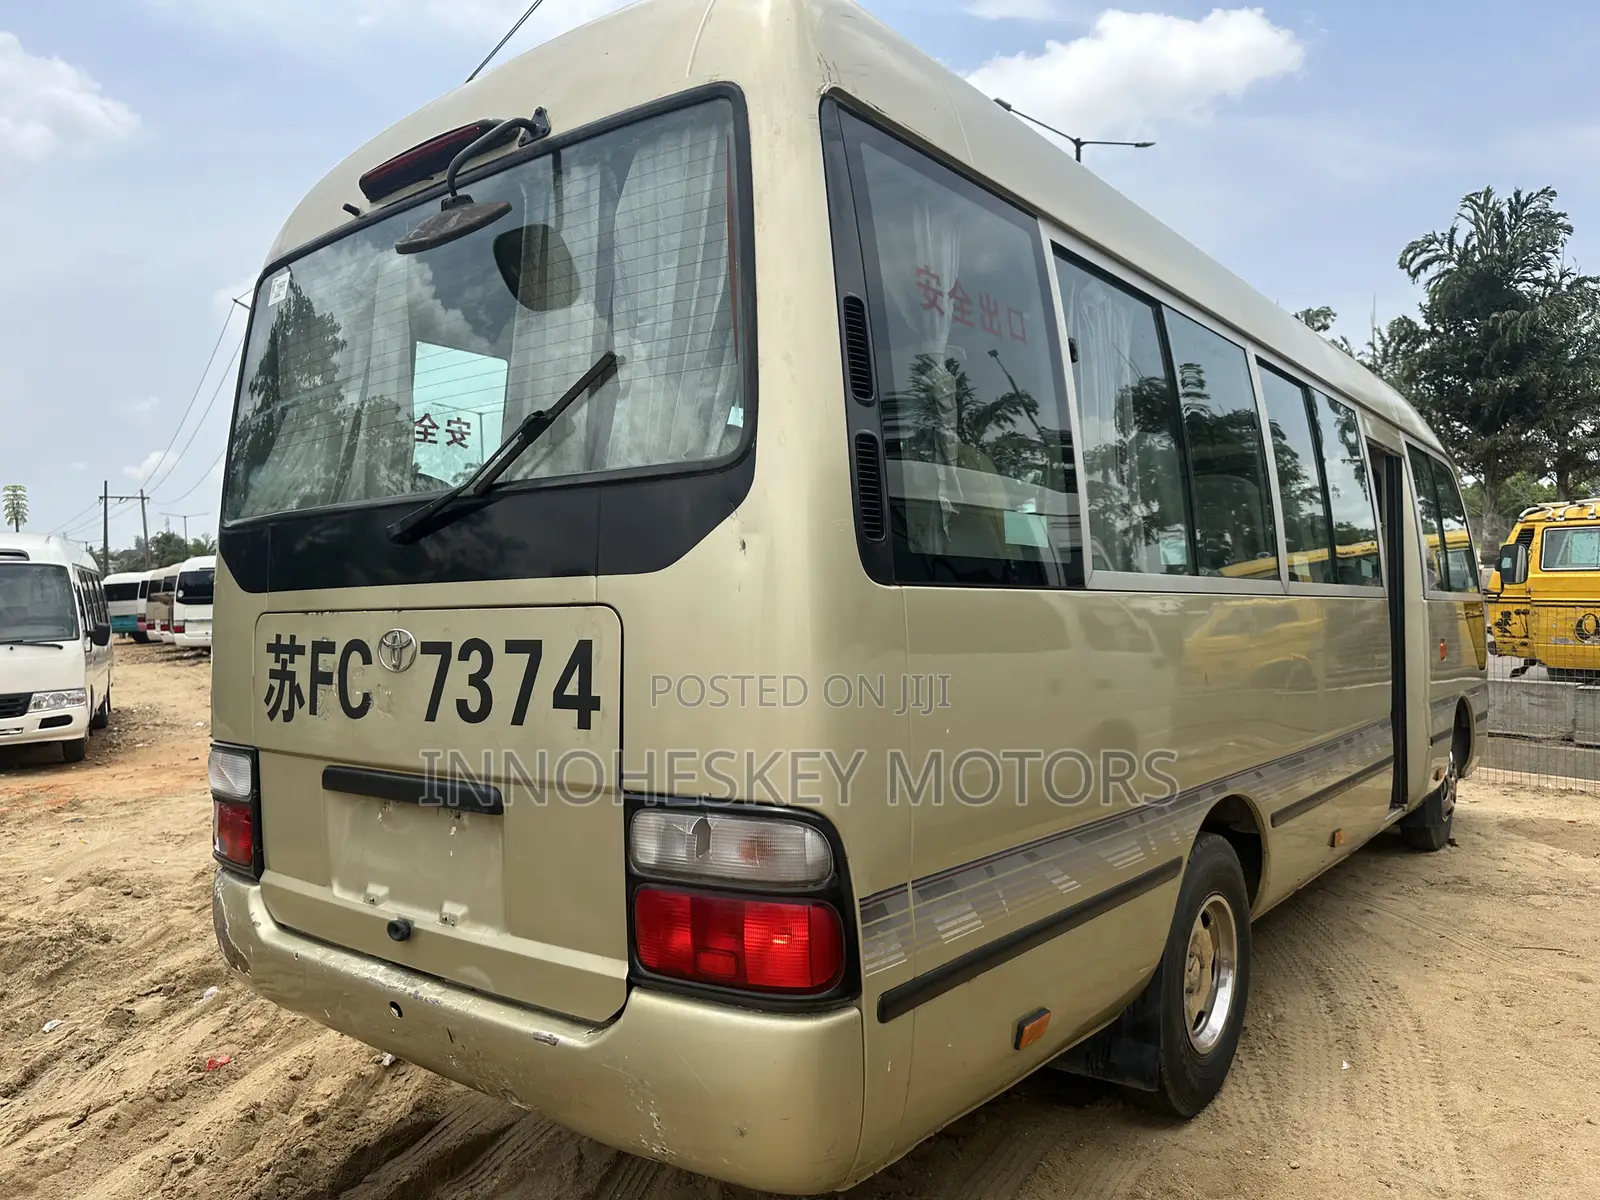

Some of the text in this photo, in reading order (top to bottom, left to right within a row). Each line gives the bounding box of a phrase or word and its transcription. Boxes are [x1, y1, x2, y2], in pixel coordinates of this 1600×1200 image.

[915, 265, 1027, 345] 安全出口
[419, 637, 601, 730] 7374
